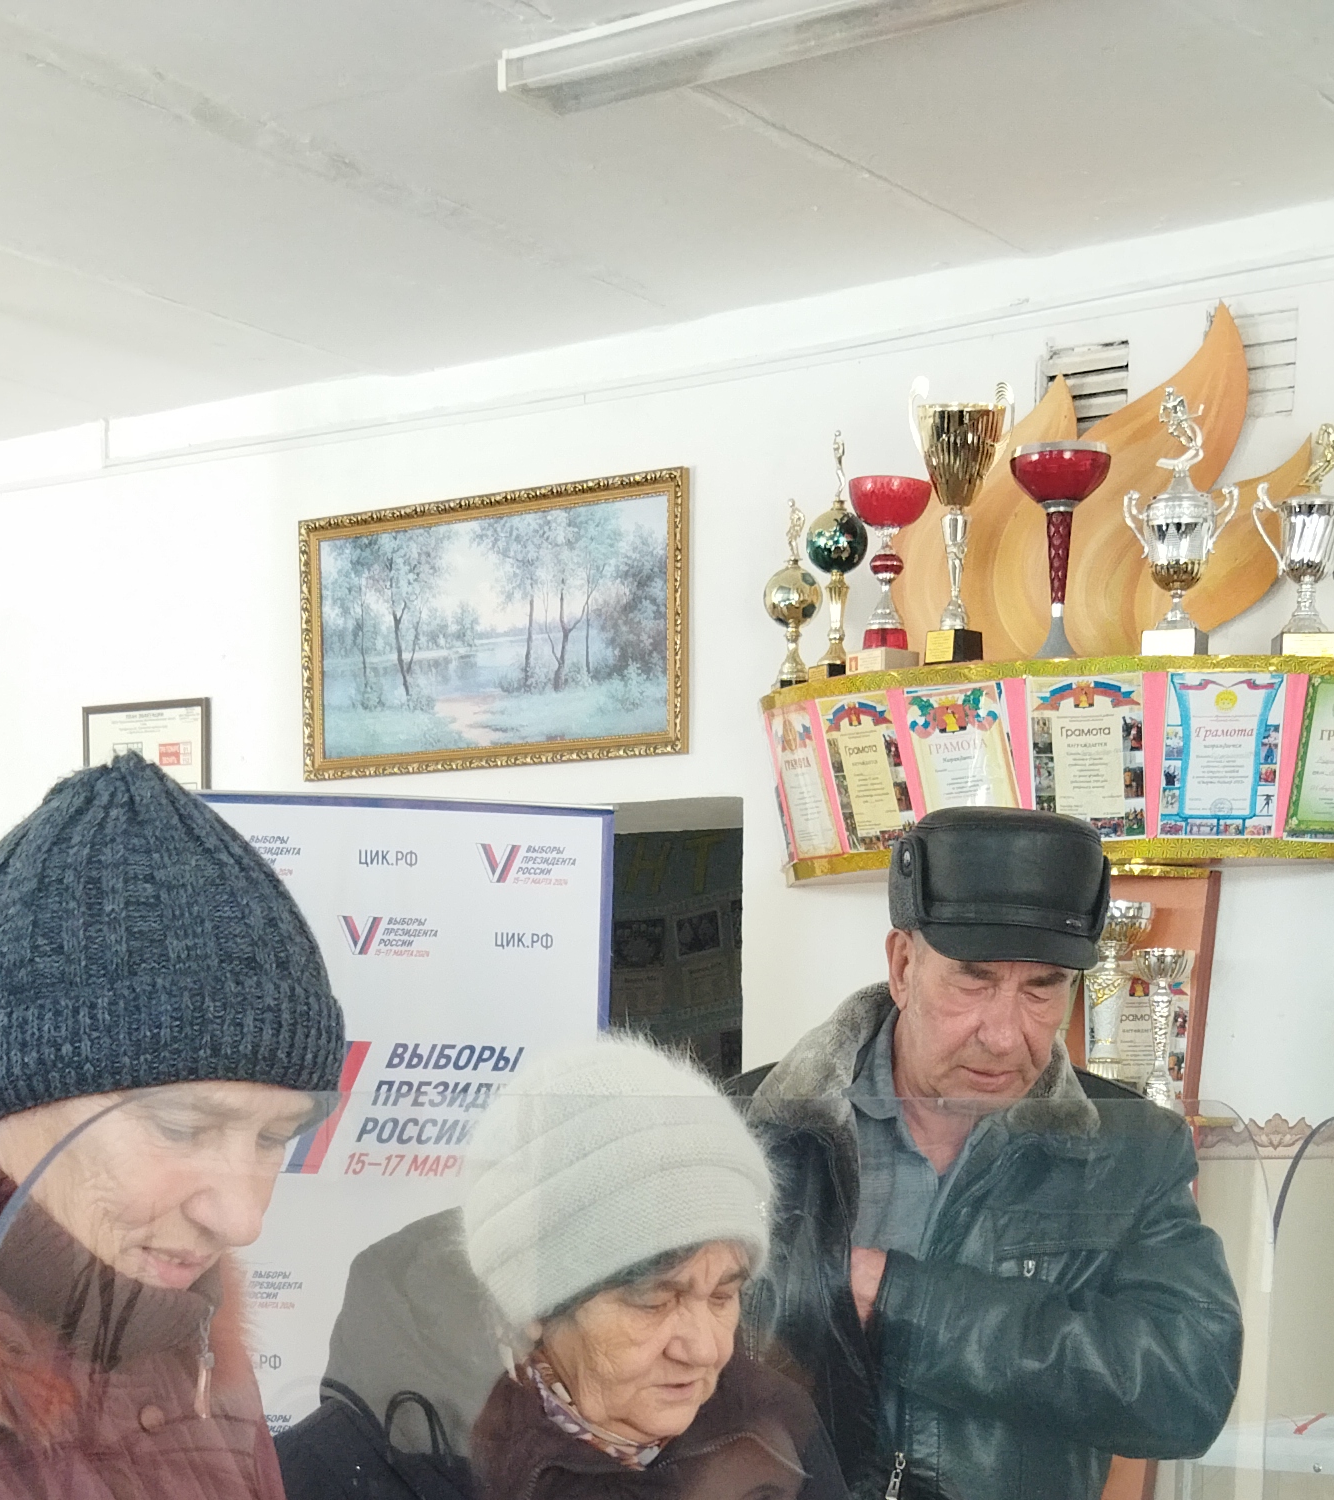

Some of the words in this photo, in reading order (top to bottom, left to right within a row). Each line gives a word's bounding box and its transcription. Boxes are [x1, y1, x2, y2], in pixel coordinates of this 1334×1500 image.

[1060, 726, 1111, 739] Грамота
[1194, 726, 1255, 742] Грамота
[844, 744, 878, 757] Грамота
[248, 835, 290, 845] ВЫБОРЫ
[525, 845, 566, 855] ВЫБОРЫ
[358, 849, 418, 867] ЦИК.РФ
[520, 856, 577, 867] ПРЕЗИДЕНТА
[515, 866, 553, 876] РОССИИ
[530, 877, 552, 886] МАРТА
[552, 878, 569, 886] 2024
[386, 917, 427, 927] ВЫБОРЫ
[382, 928, 439, 938] ПРЕЗИДЕНТА
[377, 938, 415, 948] РОССИИ
[494, 931, 554, 950] ЦИК.РФ
[393, 949, 414, 957] МАРТА
[414, 950, 430, 958] 2024
[1120, 1012, 1152, 1024] рамо
[385, 1042, 526, 1073] ВЫБОРЫ
[371, 1079, 496, 1113] ПРЕЗИД
[251, 1270, 292, 1280] ВЫБОРЫ
[279, 1302, 296, 1310] 2024
[253, 1353, 282, 1371] .РФ
[266, 1414, 292, 1423] БОРЫ
